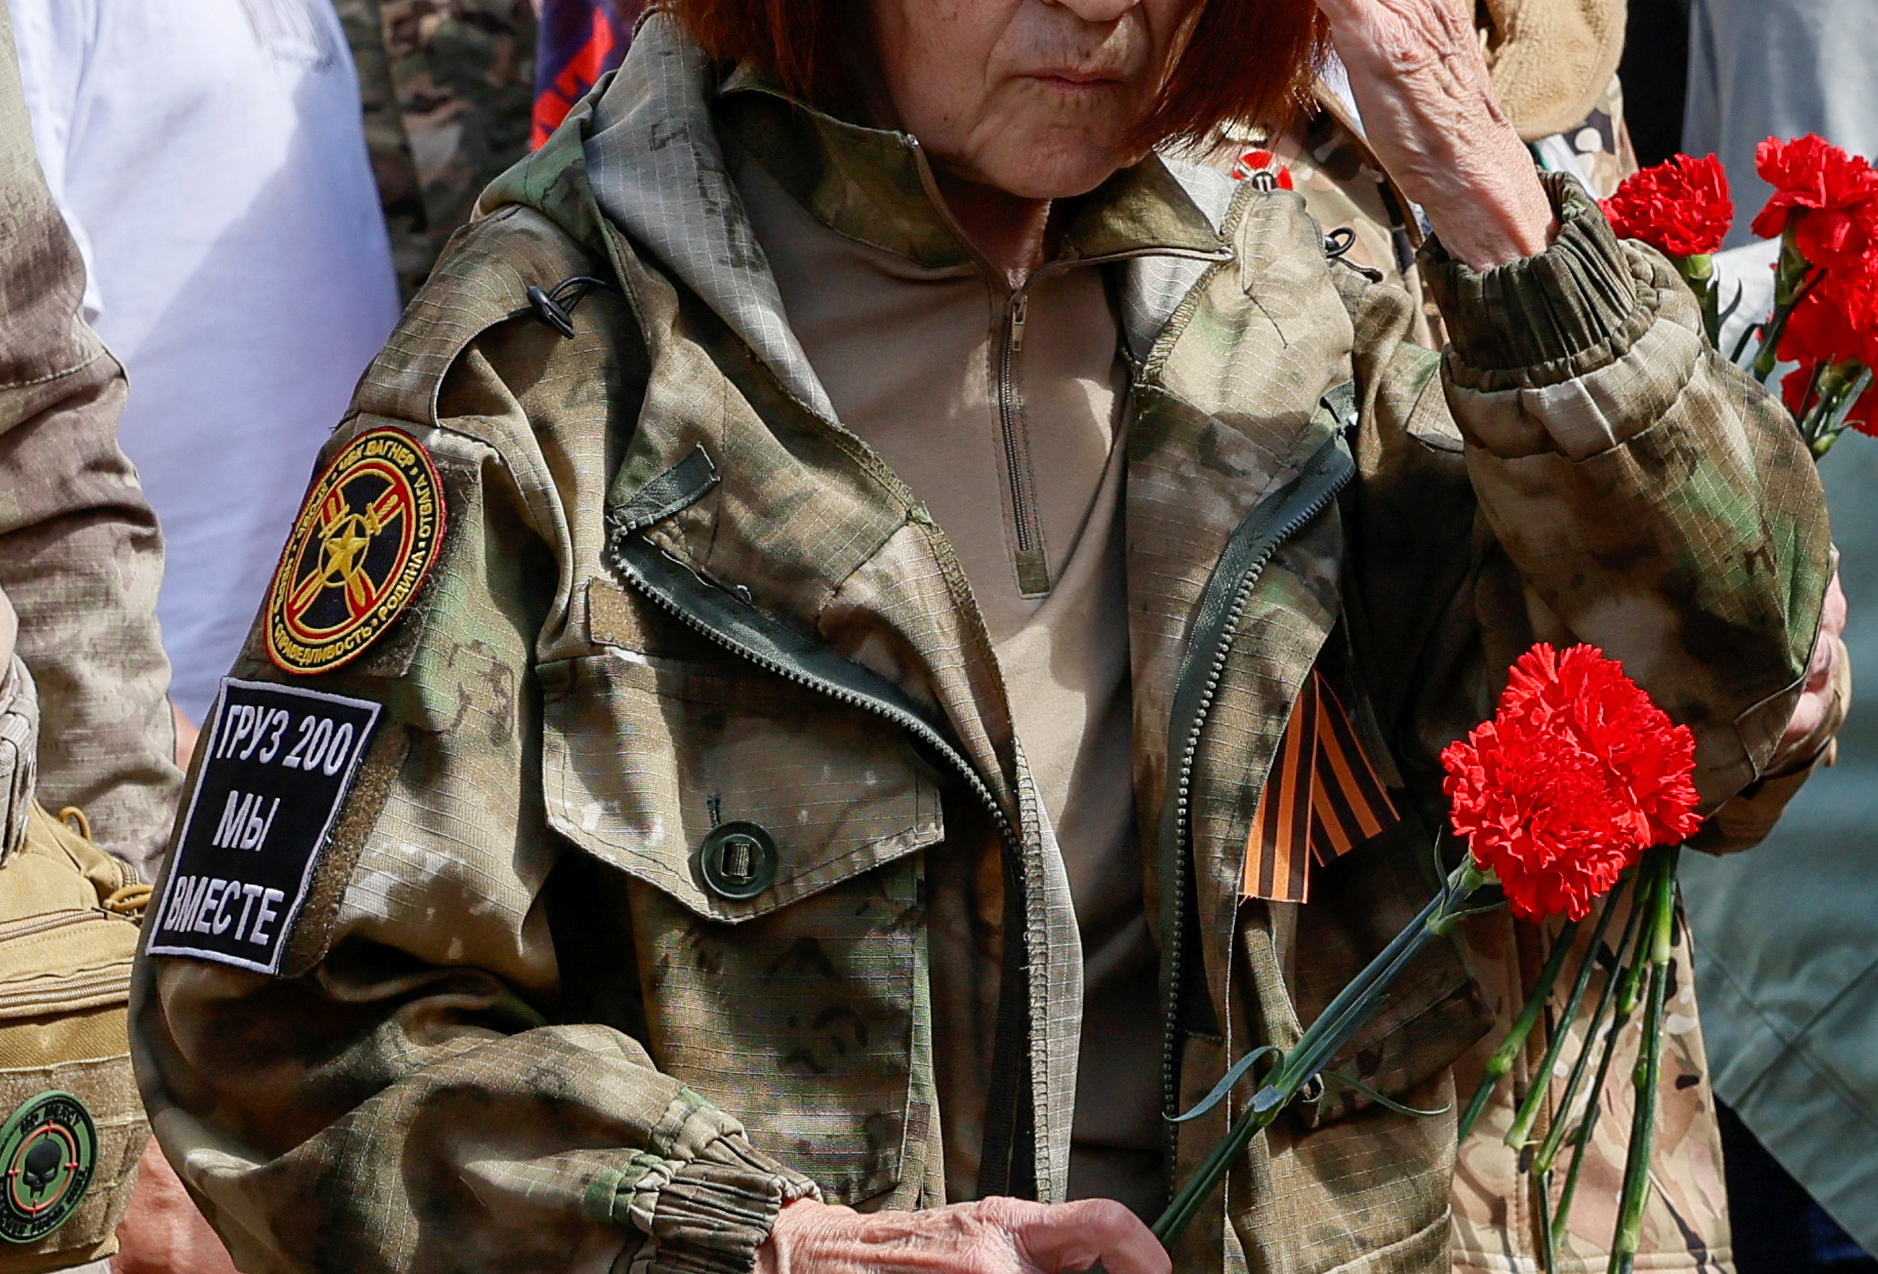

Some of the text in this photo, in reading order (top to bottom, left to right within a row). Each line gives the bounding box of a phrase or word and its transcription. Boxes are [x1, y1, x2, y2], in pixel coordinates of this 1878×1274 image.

[364, 438, 416, 468] ВАГНЕР
[413, 474, 433, 539] ОТВАГА
[379, 549, 427, 622] РОДИНА
[216, 705, 354, 777] ГРУЗ 200
[211, 790, 281, 852] МЫ
[163, 875, 285, 946] ВМЕСТЕ
